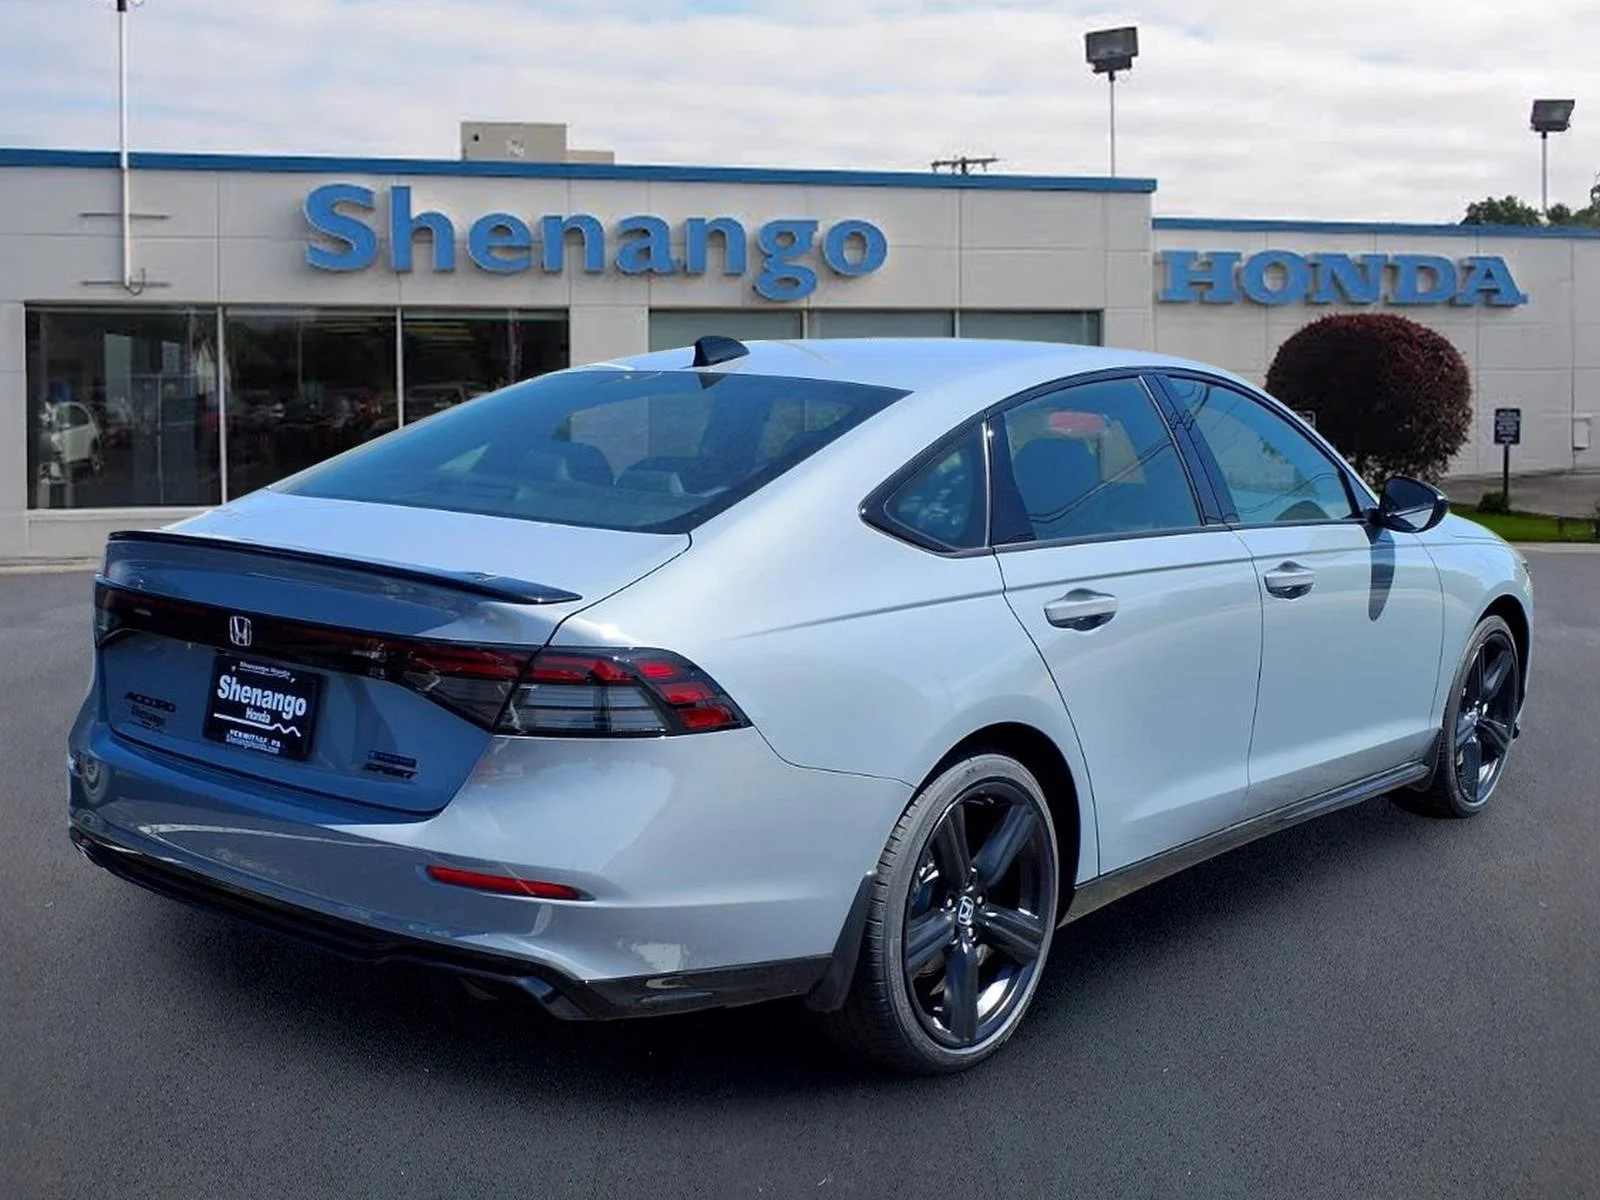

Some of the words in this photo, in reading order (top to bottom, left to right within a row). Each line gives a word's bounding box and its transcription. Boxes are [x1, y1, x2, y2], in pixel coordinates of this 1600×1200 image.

[302, 182, 888, 300] Shenango
[1157, 249, 1528, 306] HONDA
[124, 691, 177, 713] ACCORD
[217, 674, 307, 720] Shenango
[245, 707, 271, 723] Honda
